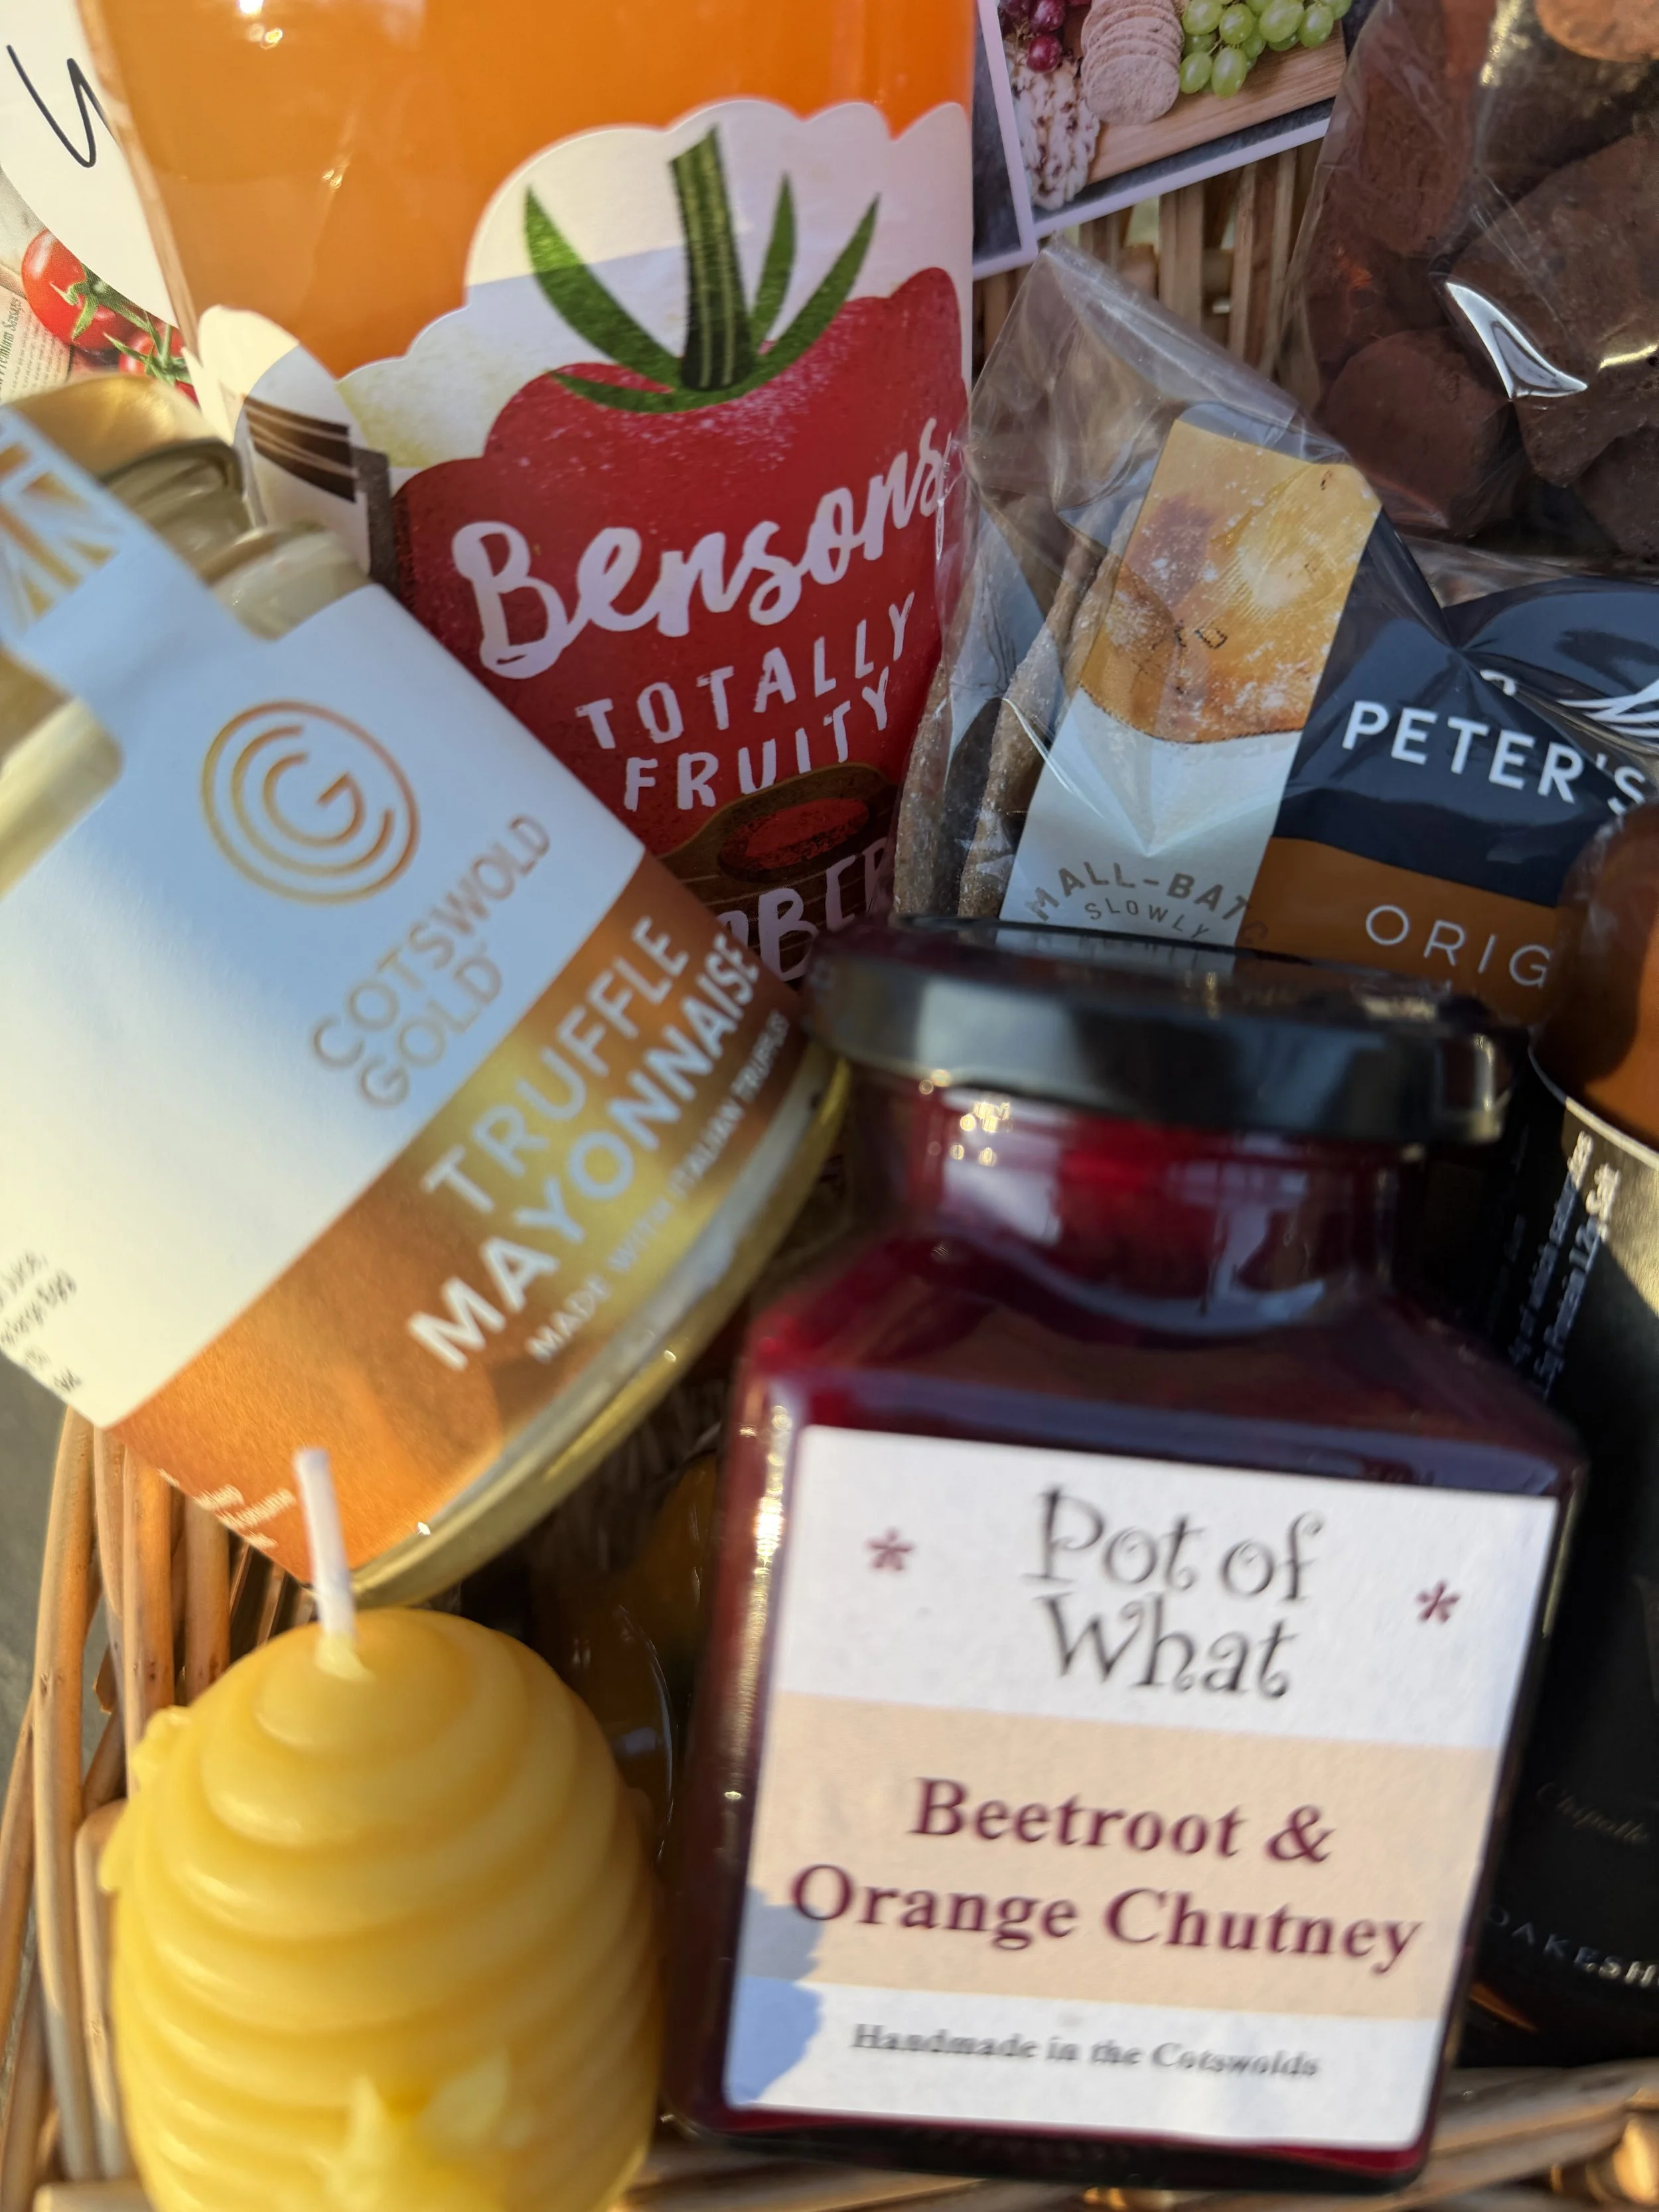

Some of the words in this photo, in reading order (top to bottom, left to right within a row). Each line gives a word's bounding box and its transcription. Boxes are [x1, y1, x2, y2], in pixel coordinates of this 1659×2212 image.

[452, 417, 952, 679] Bensons
[575, 592, 915, 749] TOTALLY
[624, 666, 889, 812] FRUITY
[1342, 700, 1648, 817] PETER'S
[313, 814, 551, 1070] COTSWOLD
[1084, 897, 1211, 940] SLOWLY
[359, 954, 502, 1109] GOLD
[420, 916, 689, 1215] TRUFFLE
[407, 933, 760, 1371] MAYONNAISE
[1023, 1484, 1206, 1591] Pot
[1220, 1512, 1325, 1602] of
[1035, 1590, 1299, 1699] What
[908, 1777, 1247, 1858] Beetroot
[1265, 1803, 1334, 1864] &
[790, 1863, 1079, 1951] Orange
[1104, 1887, 1423, 1976] Chutney
[1486, 1903, 1659, 1988] OAKESH
[851, 2022, 1037, 2063] Handmade
[1046, 2035, 1081, 2063] in
[1091, 2037, 1141, 2067] the
[1151, 2040, 1319, 2079] Cotswolds
